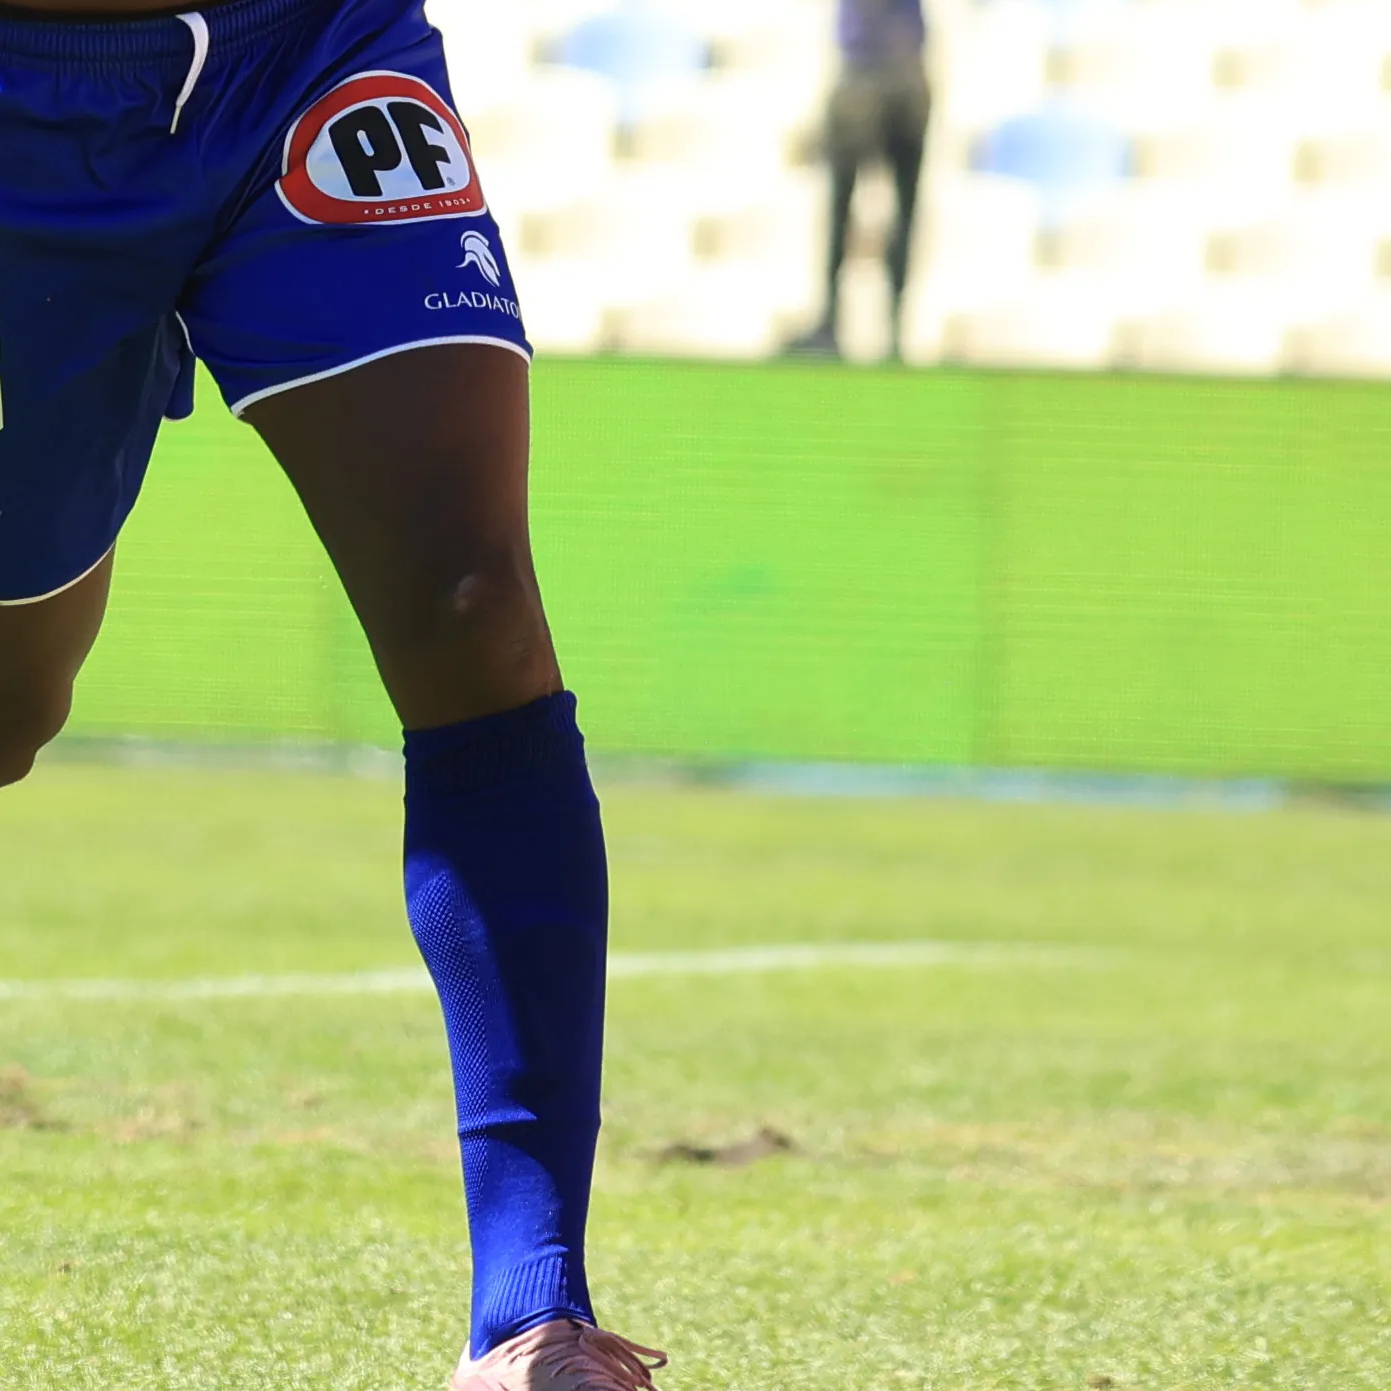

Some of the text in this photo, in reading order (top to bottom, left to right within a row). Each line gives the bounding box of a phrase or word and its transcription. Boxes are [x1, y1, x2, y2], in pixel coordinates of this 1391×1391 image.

[327, 100, 452, 198] PF
[375, 201, 433, 215] DESDE
[423, 290, 521, 319] GLADIATO
